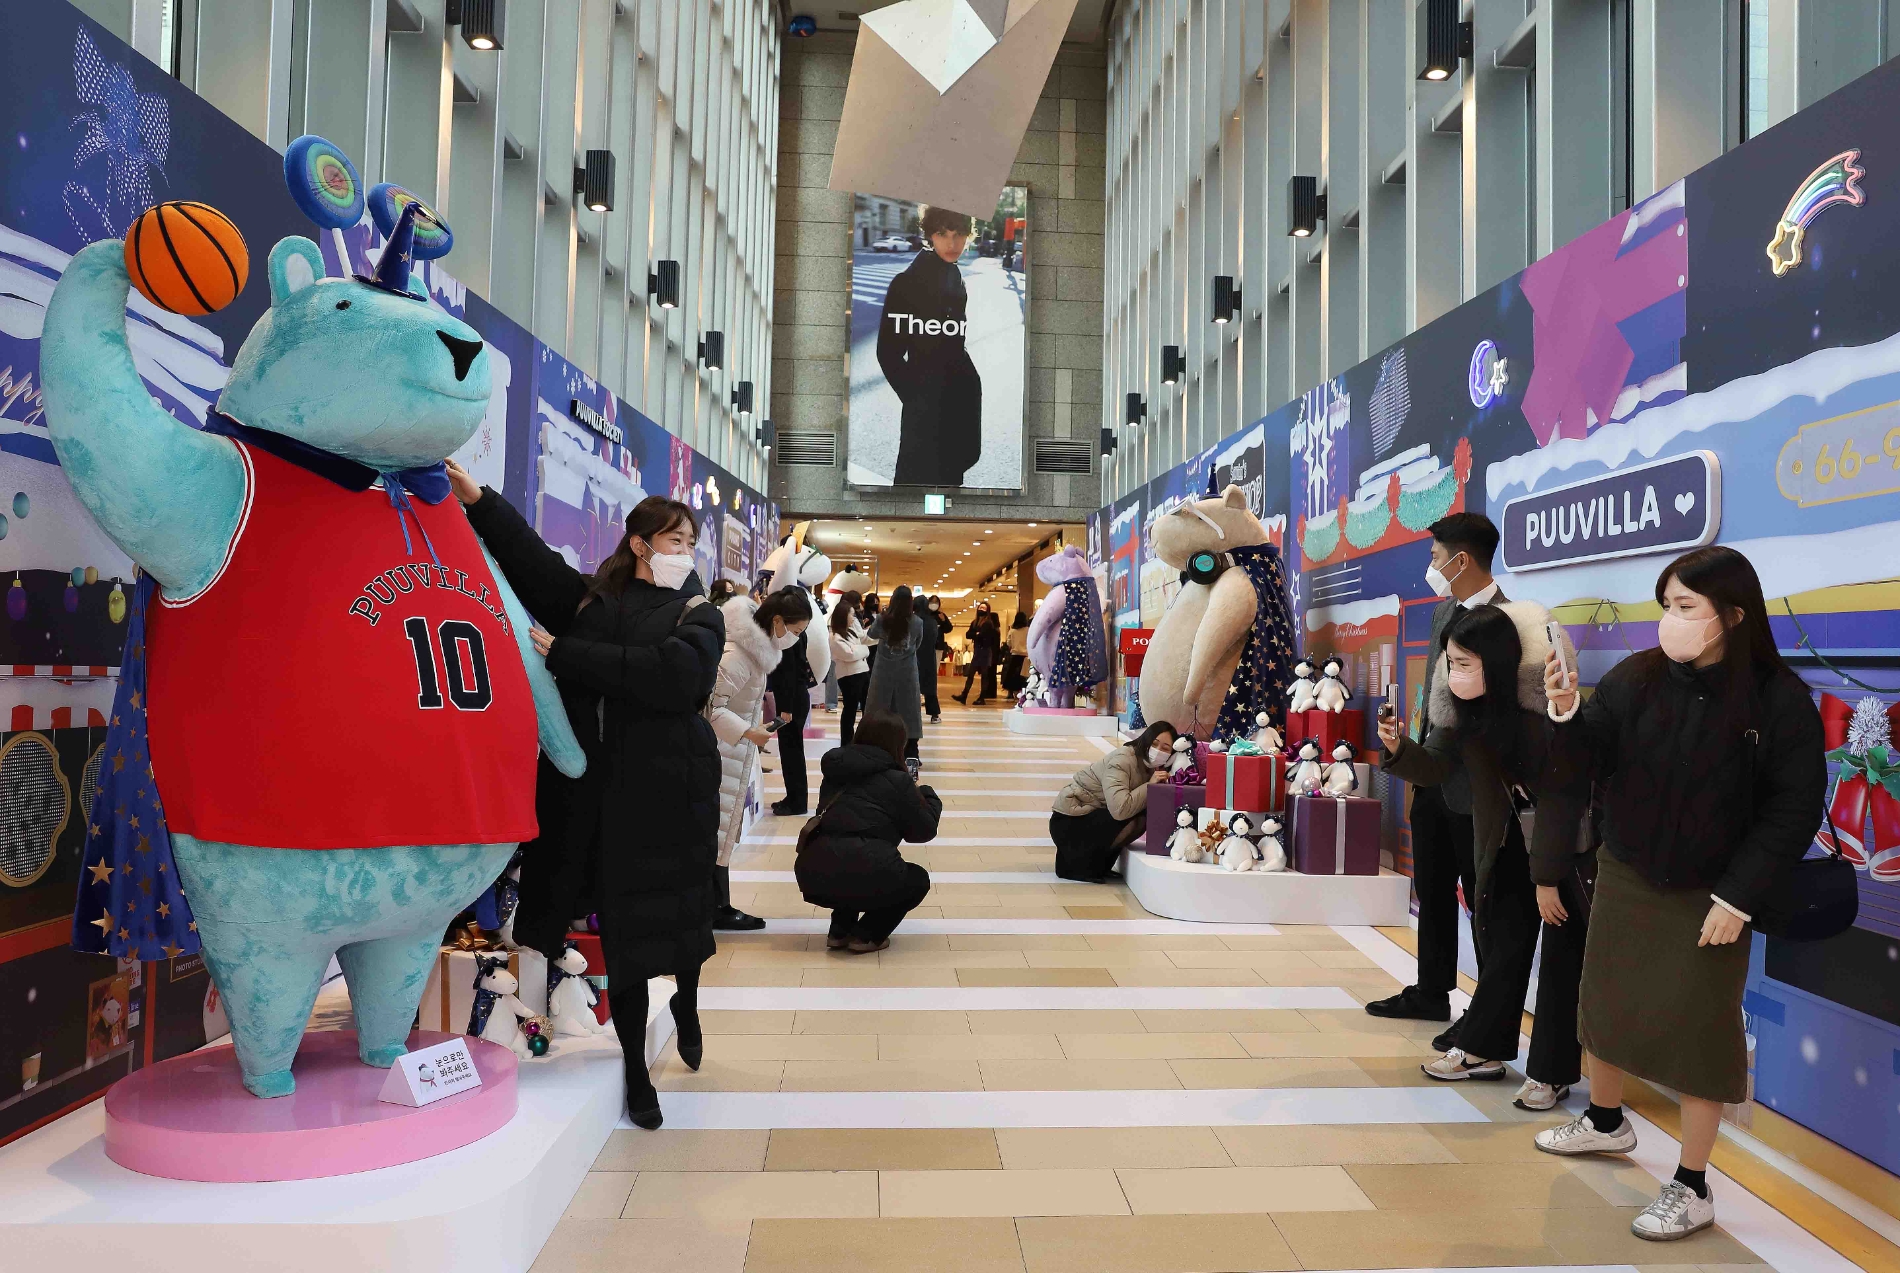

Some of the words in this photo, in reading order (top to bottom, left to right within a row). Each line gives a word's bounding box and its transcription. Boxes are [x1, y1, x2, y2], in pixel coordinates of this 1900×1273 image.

[576, 399, 603, 432] PUUVILLA
[603, 421, 623, 444] SOCIETY
[1525, 485, 1661, 551] PUUVILLA
[348, 562, 508, 636] PUUVILLA
[1132, 637, 1151, 646] PO
[403, 616, 492, 711] 10
[175, 961, 192, 973] PHOTO
[435, 1050, 465, 1067] 눈으로만
[439, 1061, 470, 1077] 봐주세요
